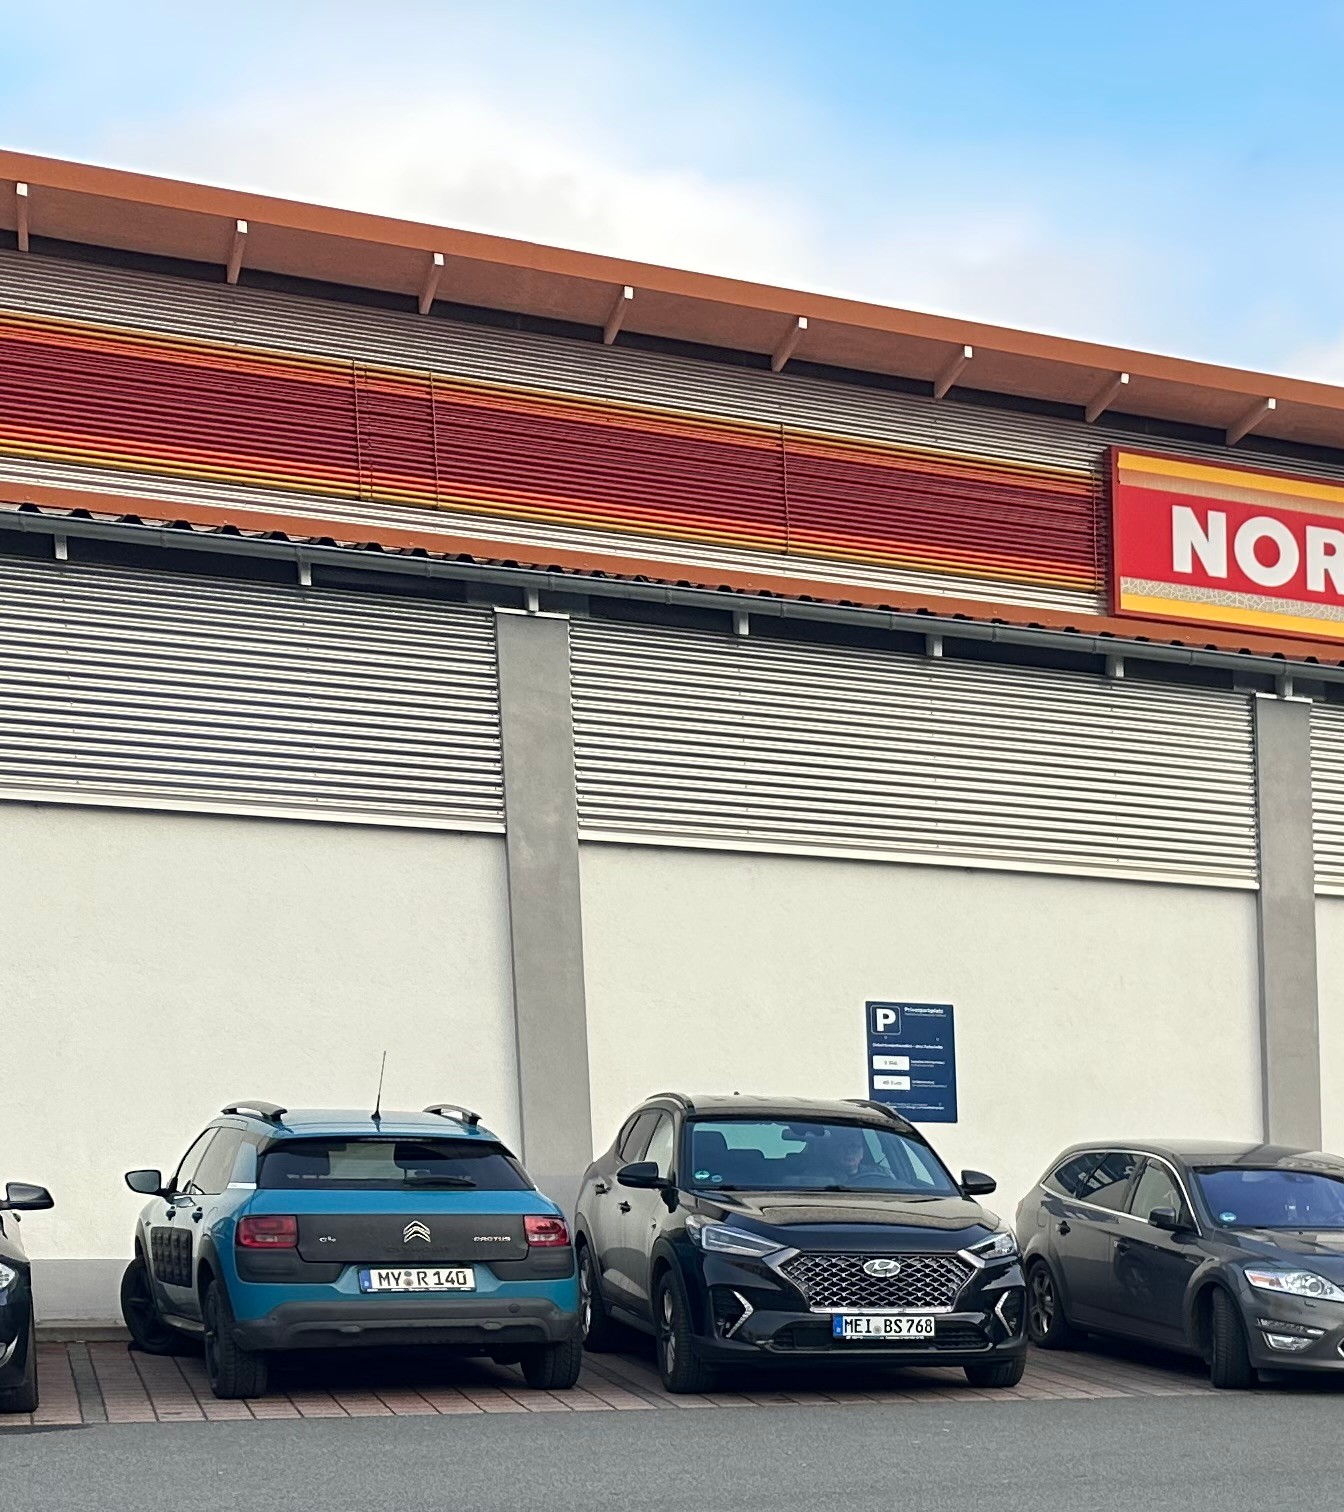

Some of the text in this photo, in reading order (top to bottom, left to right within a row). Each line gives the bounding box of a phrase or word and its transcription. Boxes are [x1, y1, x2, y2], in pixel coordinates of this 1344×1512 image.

[876, 1008, 896, 1032] P
[378, 1269, 468, 1287] MY R 140
[844, 1318, 933, 1334] MEI BS 768
